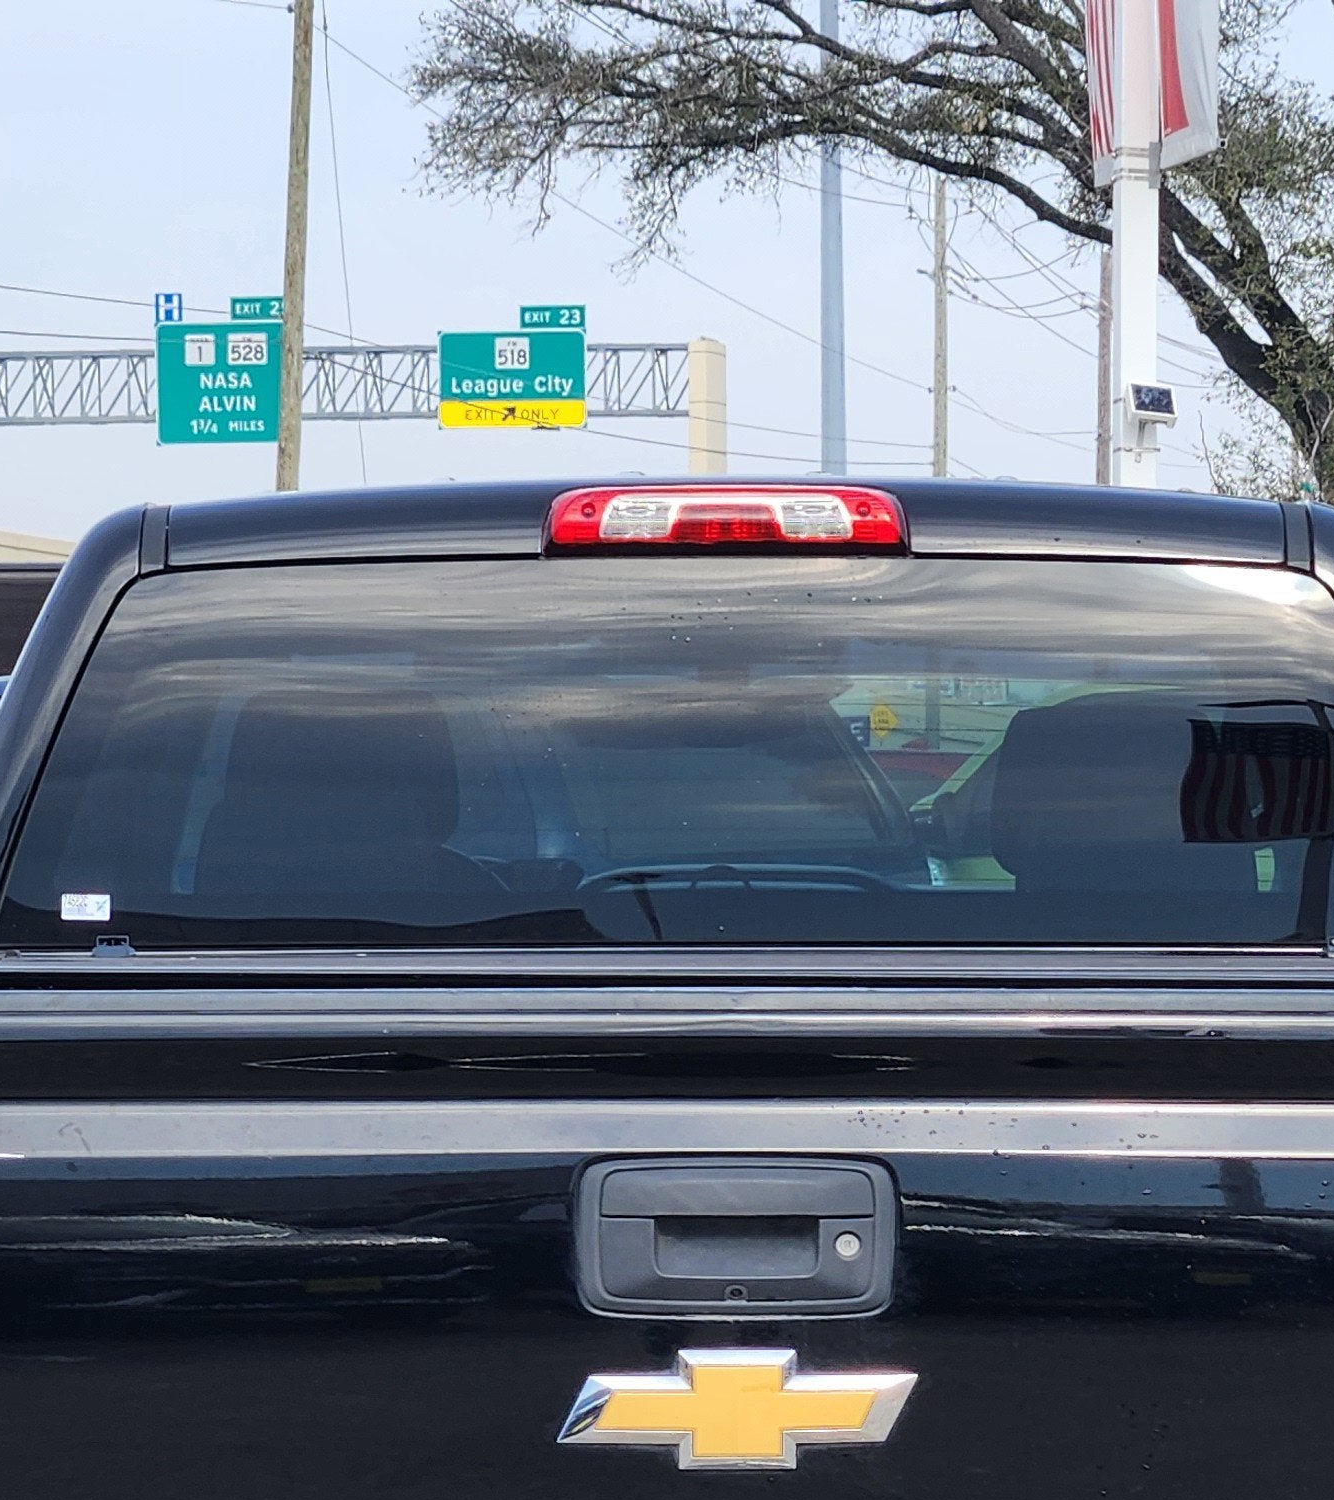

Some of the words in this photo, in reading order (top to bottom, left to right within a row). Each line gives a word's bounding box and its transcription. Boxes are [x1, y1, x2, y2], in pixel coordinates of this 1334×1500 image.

[234, 302, 261, 315] EXIT
[269, 301, 284, 316] 2
[523, 310, 551, 323] EXIT
[559, 309, 581, 325] 23
[197, 345, 203, 362] 1
[230, 344, 265, 361] 528
[497, 349, 527, 366] 518
[199, 371, 253, 389] NASA
[450, 376, 524, 397] League
[534, 374, 574, 396] City
[198, 394, 257, 412] ALVIN
[464, 409, 496, 420] EXIT
[520, 408, 560, 420] ONLY
[228, 420, 266, 432] MILES
